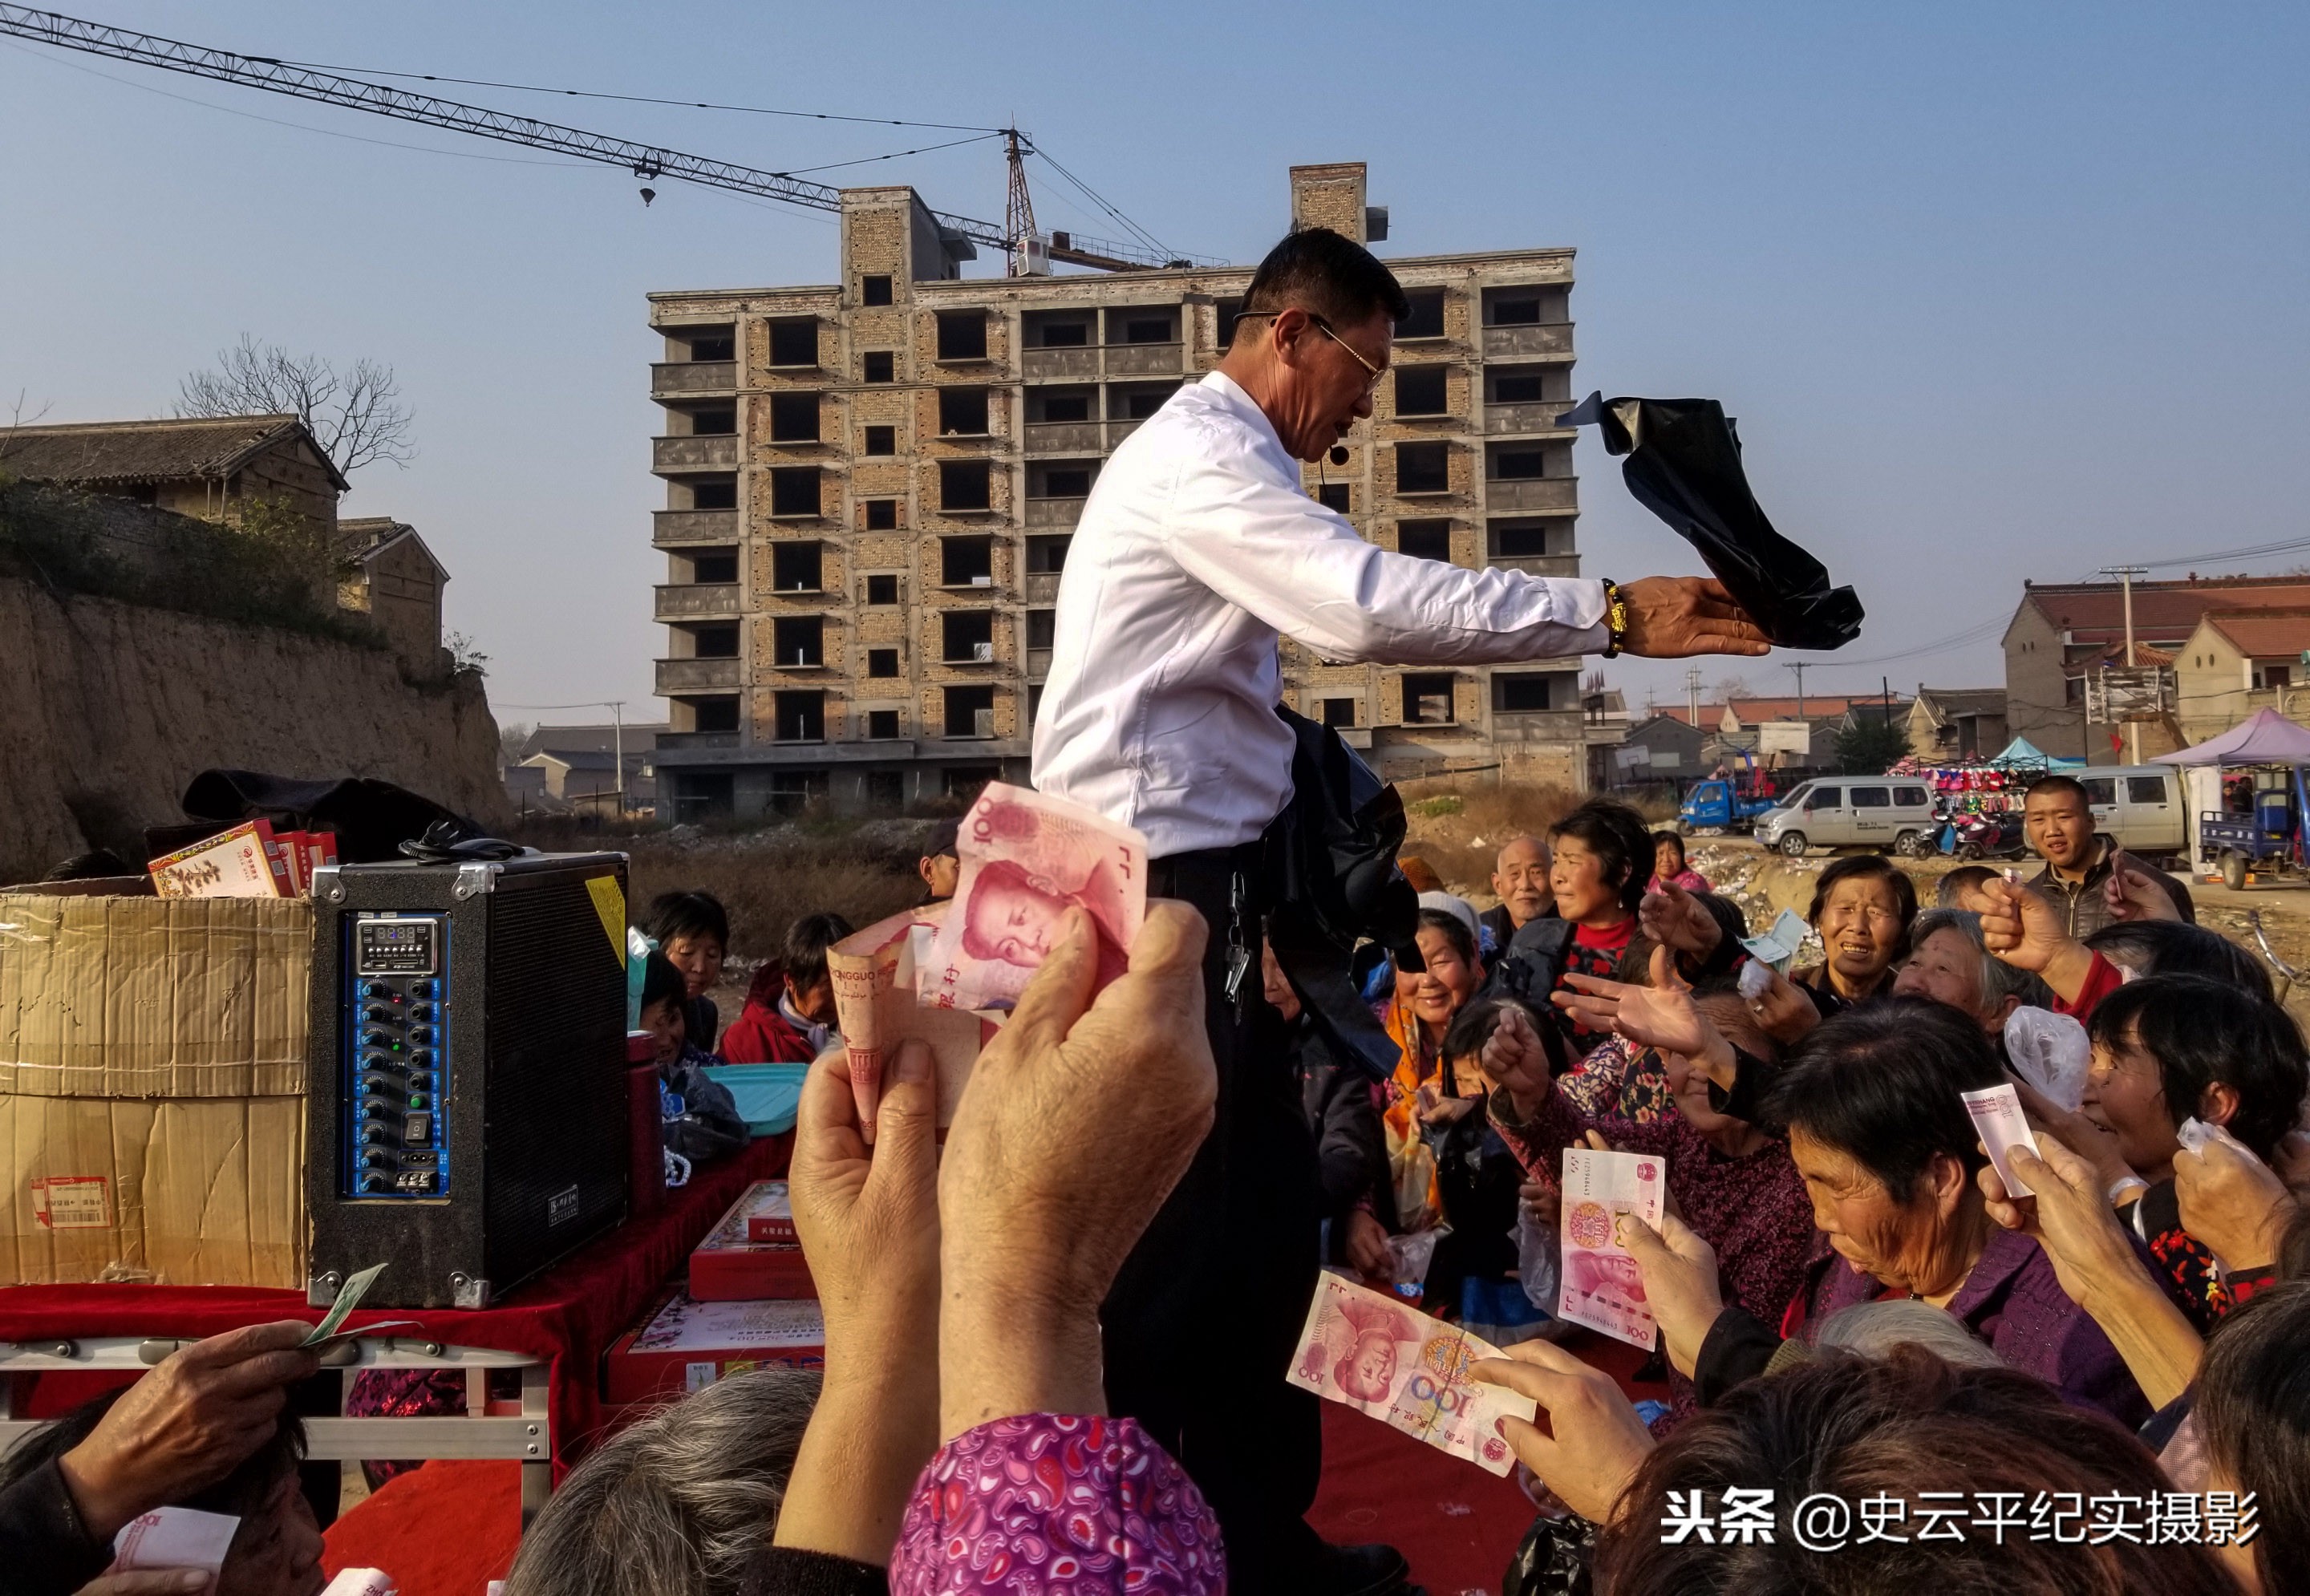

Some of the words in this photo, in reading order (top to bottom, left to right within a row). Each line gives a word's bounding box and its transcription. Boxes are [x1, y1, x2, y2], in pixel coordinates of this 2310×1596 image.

[973, 796, 995, 844] 100
[1625, 1324, 1649, 1342] 100
[1298, 1366, 1324, 1386] 100
[1411, 1375, 1474, 1418] 100
